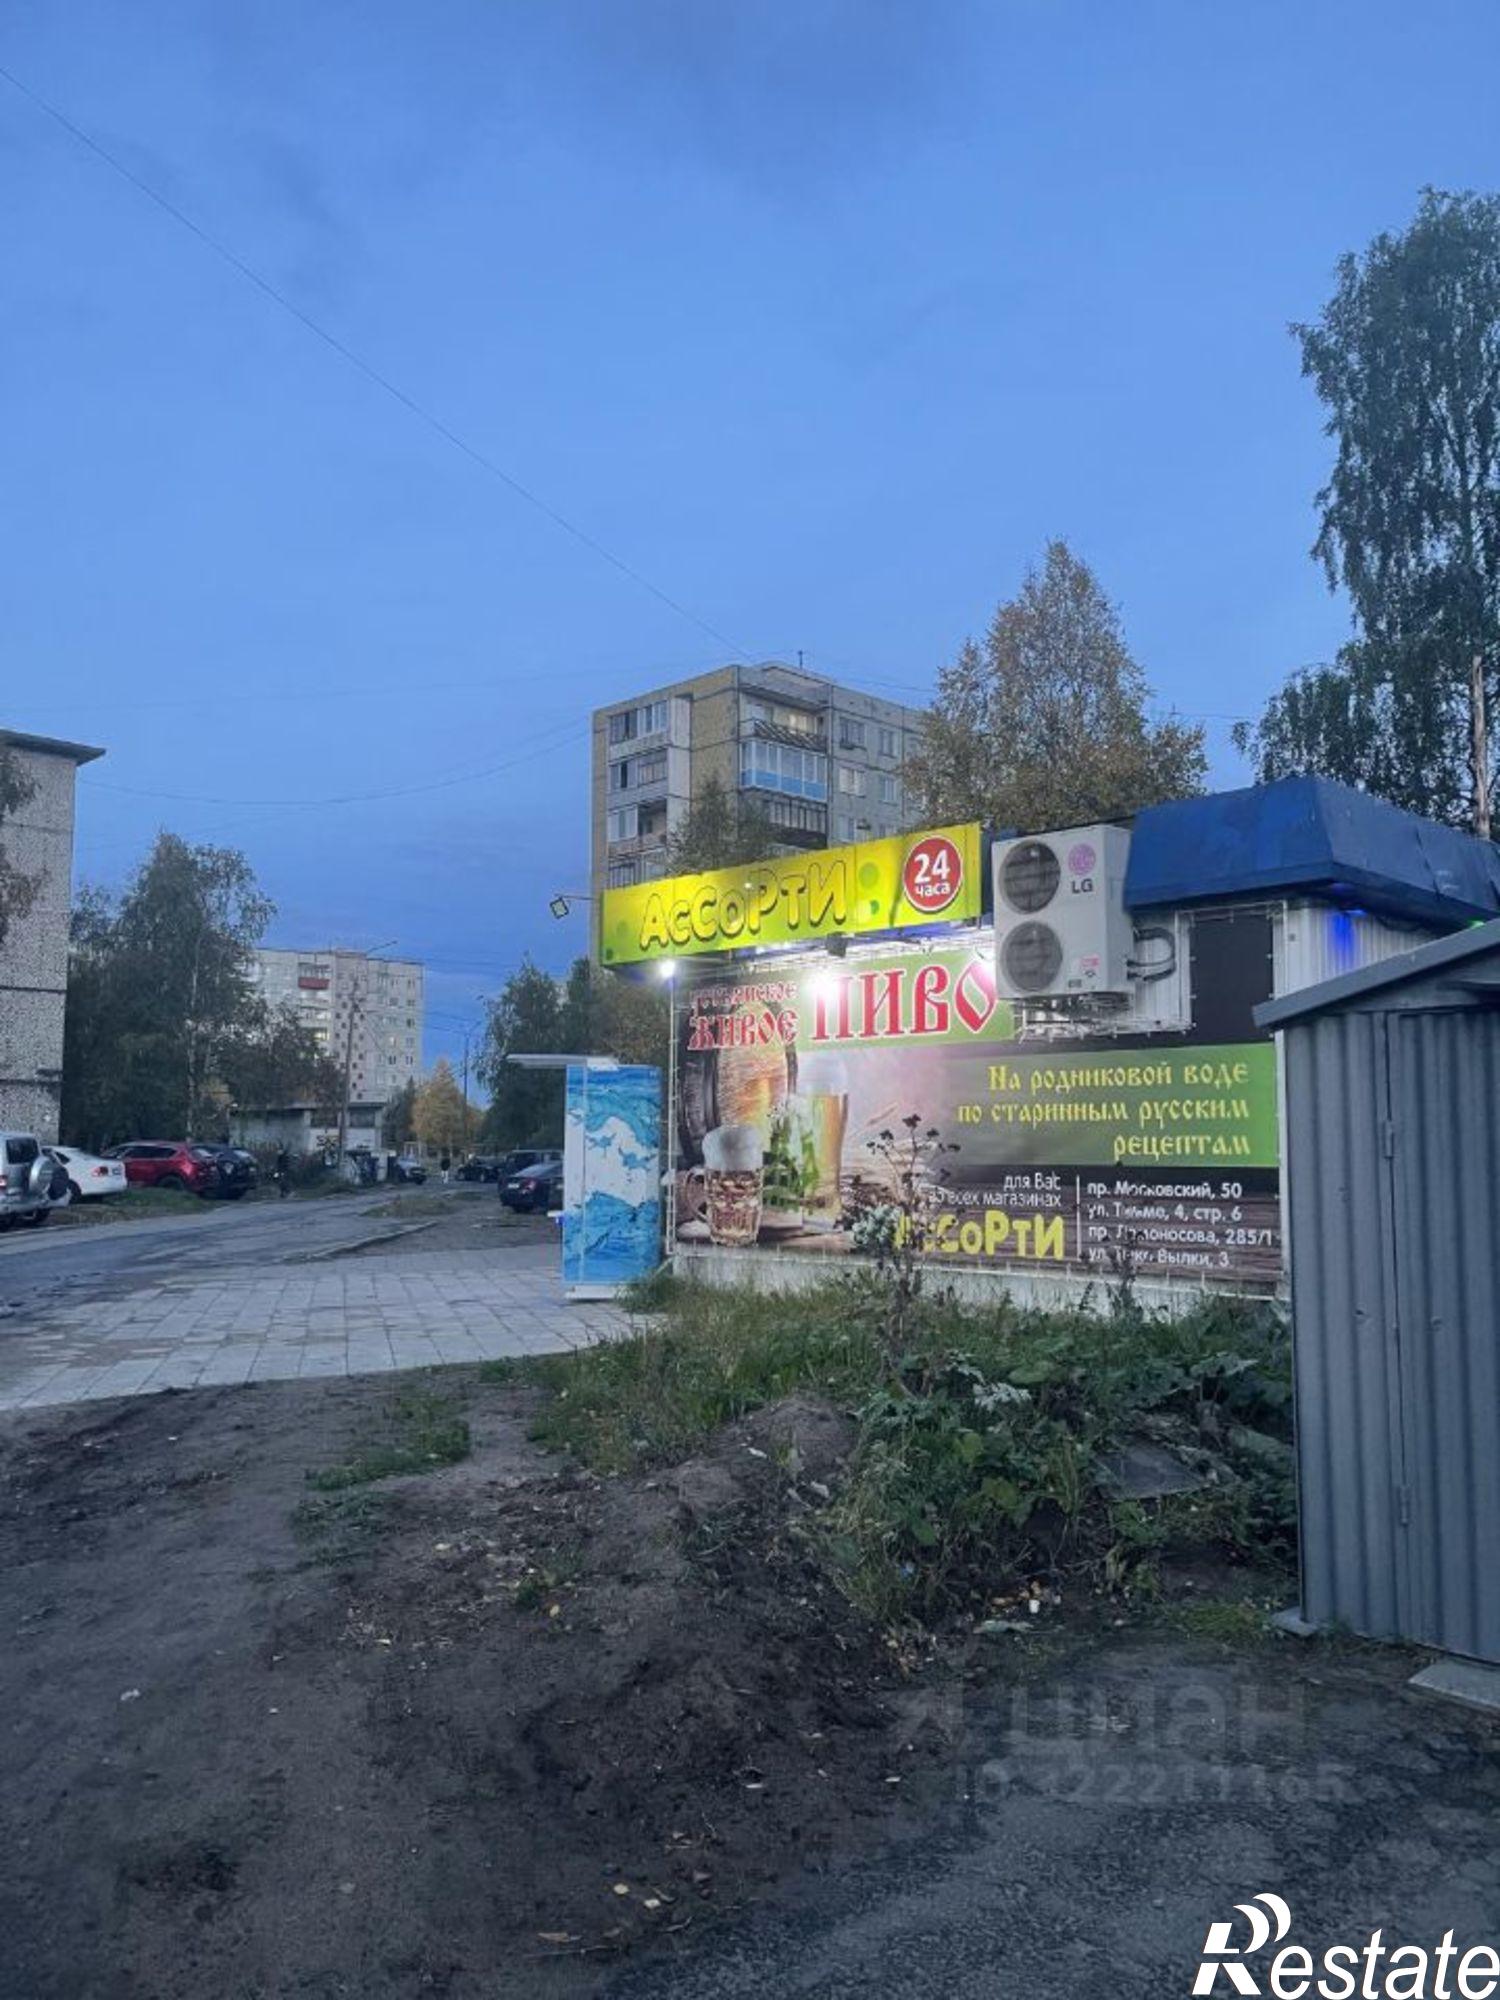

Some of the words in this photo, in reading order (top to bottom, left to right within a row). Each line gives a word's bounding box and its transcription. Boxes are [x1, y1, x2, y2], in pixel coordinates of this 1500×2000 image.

[913, 850, 951, 883] 24
[914, 882, 951, 899] часа
[1071, 878, 1094, 894] LG
[808, 958, 999, 1042] ПИВО
[987, 1065, 1022, 1092] На
[1030, 1061, 1173, 1096] родниковой
[1184, 1063, 1249, 1089] воде
[958, 1105, 983, 1124] по
[991, 1101, 1129, 1129] старинным
[1139, 1099, 1250, 1129] русским
[1113, 1135, 1251, 1161] рецептам
[1003, 1175, 1030, 1192] для
[1087, 1182, 1112, 1199] пр.
[1220, 1182, 1243, 1199] 50
[983, 1192, 1062, 1208] магазинах
[1087, 1203, 1110, 1220] ул.
[1174, 1203, 1189, 1221] 4,
[1193, 1207, 1226, 1225] стр.
[1230, 1205, 1243, 1221] 6
[1225, 1228, 1272, 1246] 285/1
[1219, 1250, 1230, 1267] 3
